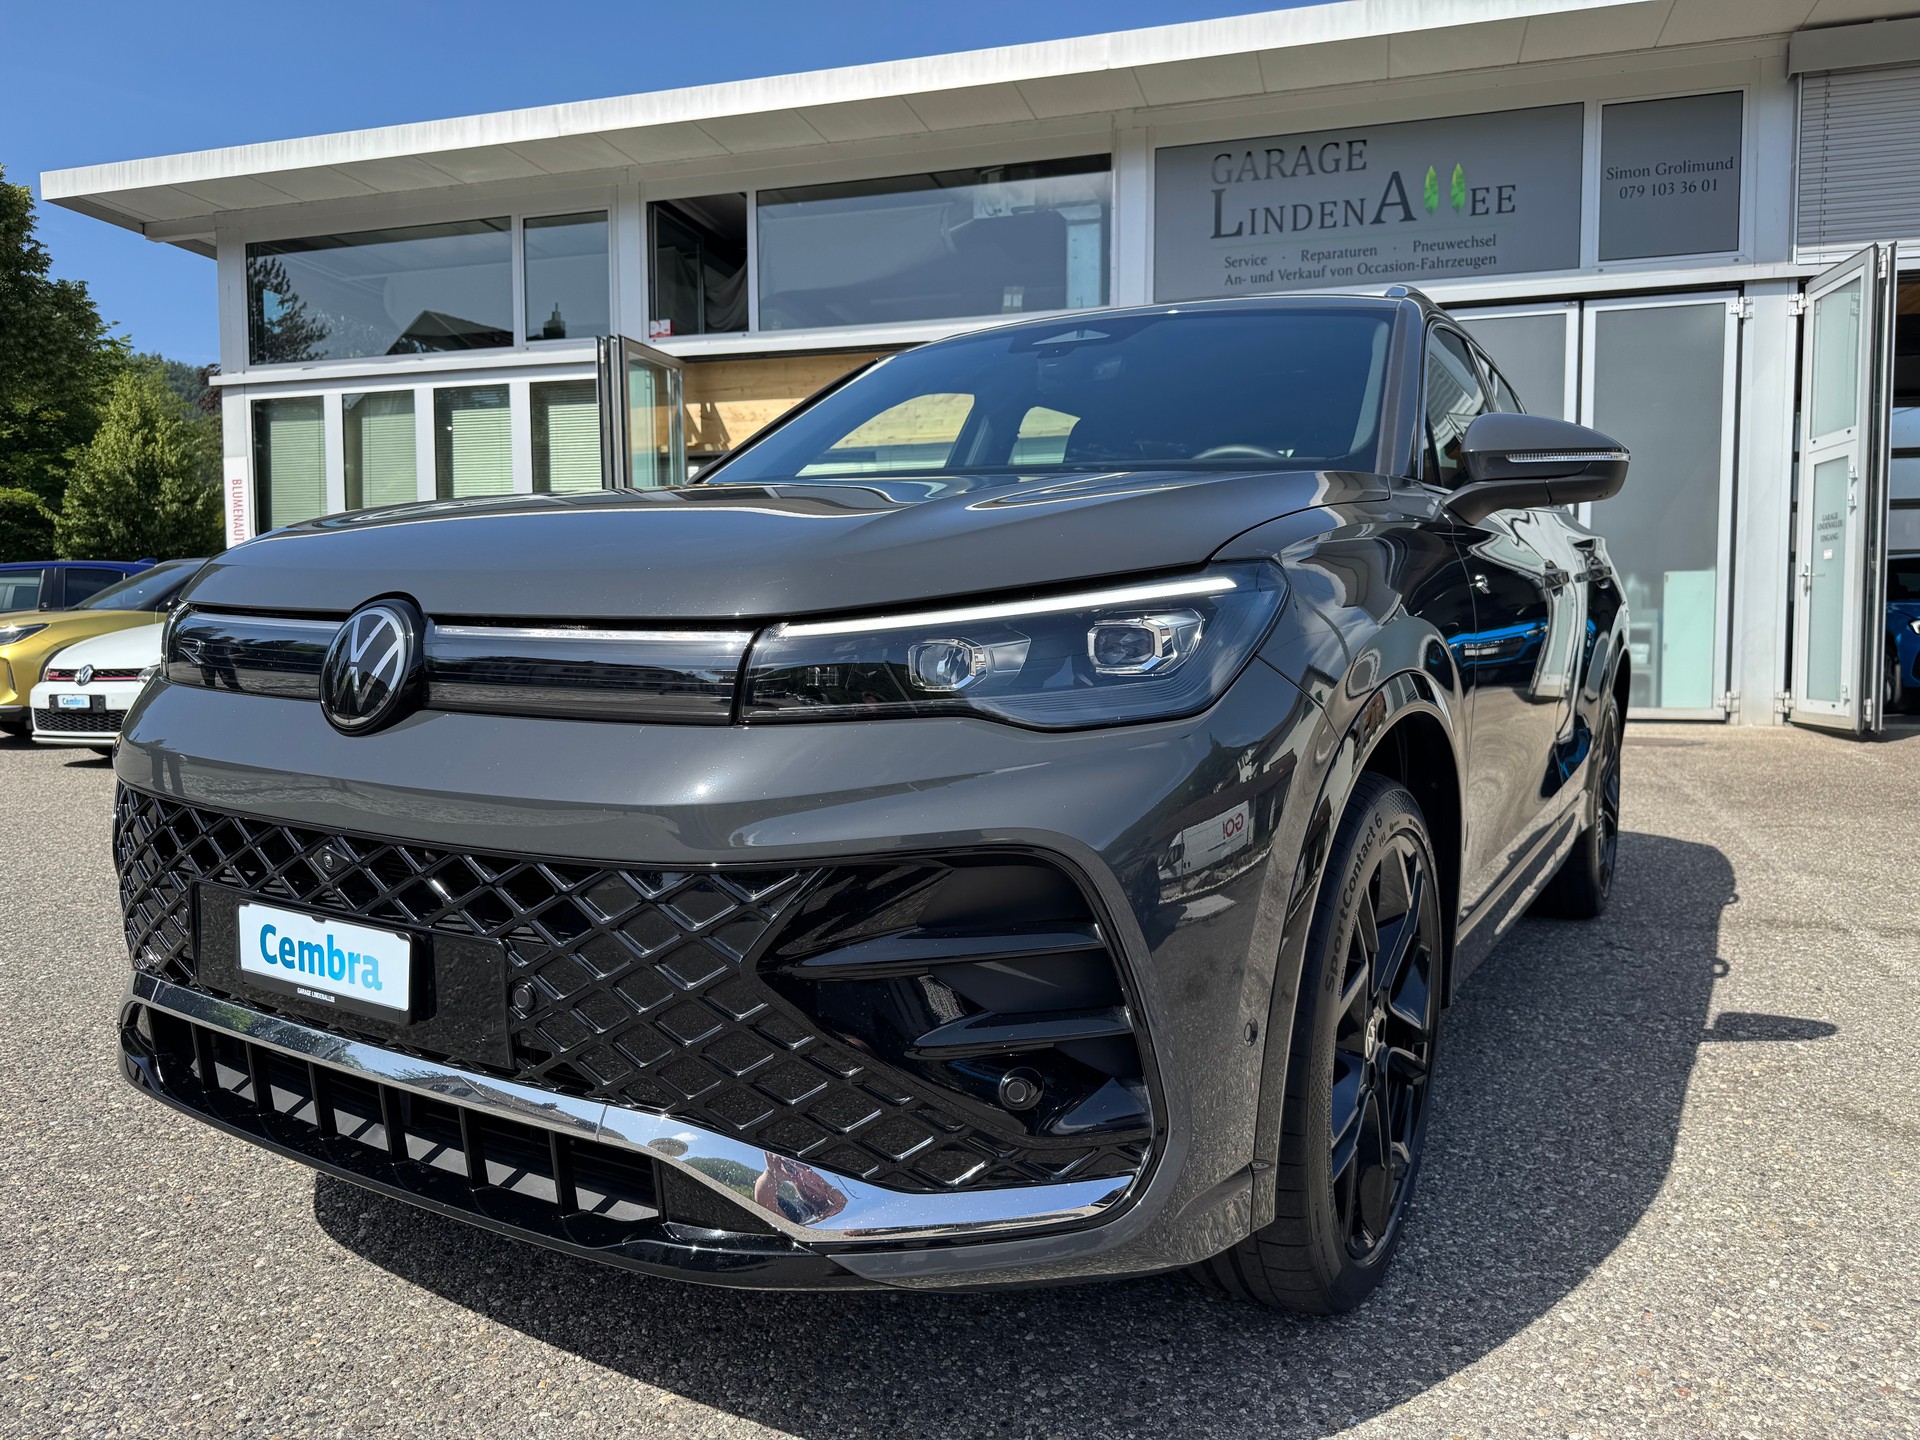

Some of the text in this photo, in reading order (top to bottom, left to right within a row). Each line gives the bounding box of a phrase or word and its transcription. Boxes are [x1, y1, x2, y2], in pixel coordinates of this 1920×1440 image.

[1211, 139, 1367, 185] GARAGE
[1606, 156, 1734, 181] Simon Grolimund
[1619, 178, 1717, 199] 079 103 36 01
[1224, 234, 1497, 269] Service Reparaturen Pneuwechsel
[1224, 255, 1497, 286] An- und Verkauf von Occasion-Fahrzeugen
[232, 479, 245, 542] BLUMENAUT
[1324, 824, 1376, 994] SportContact
[1374, 812, 1383, 828] 6
[259, 923, 383, 991] Cembra
